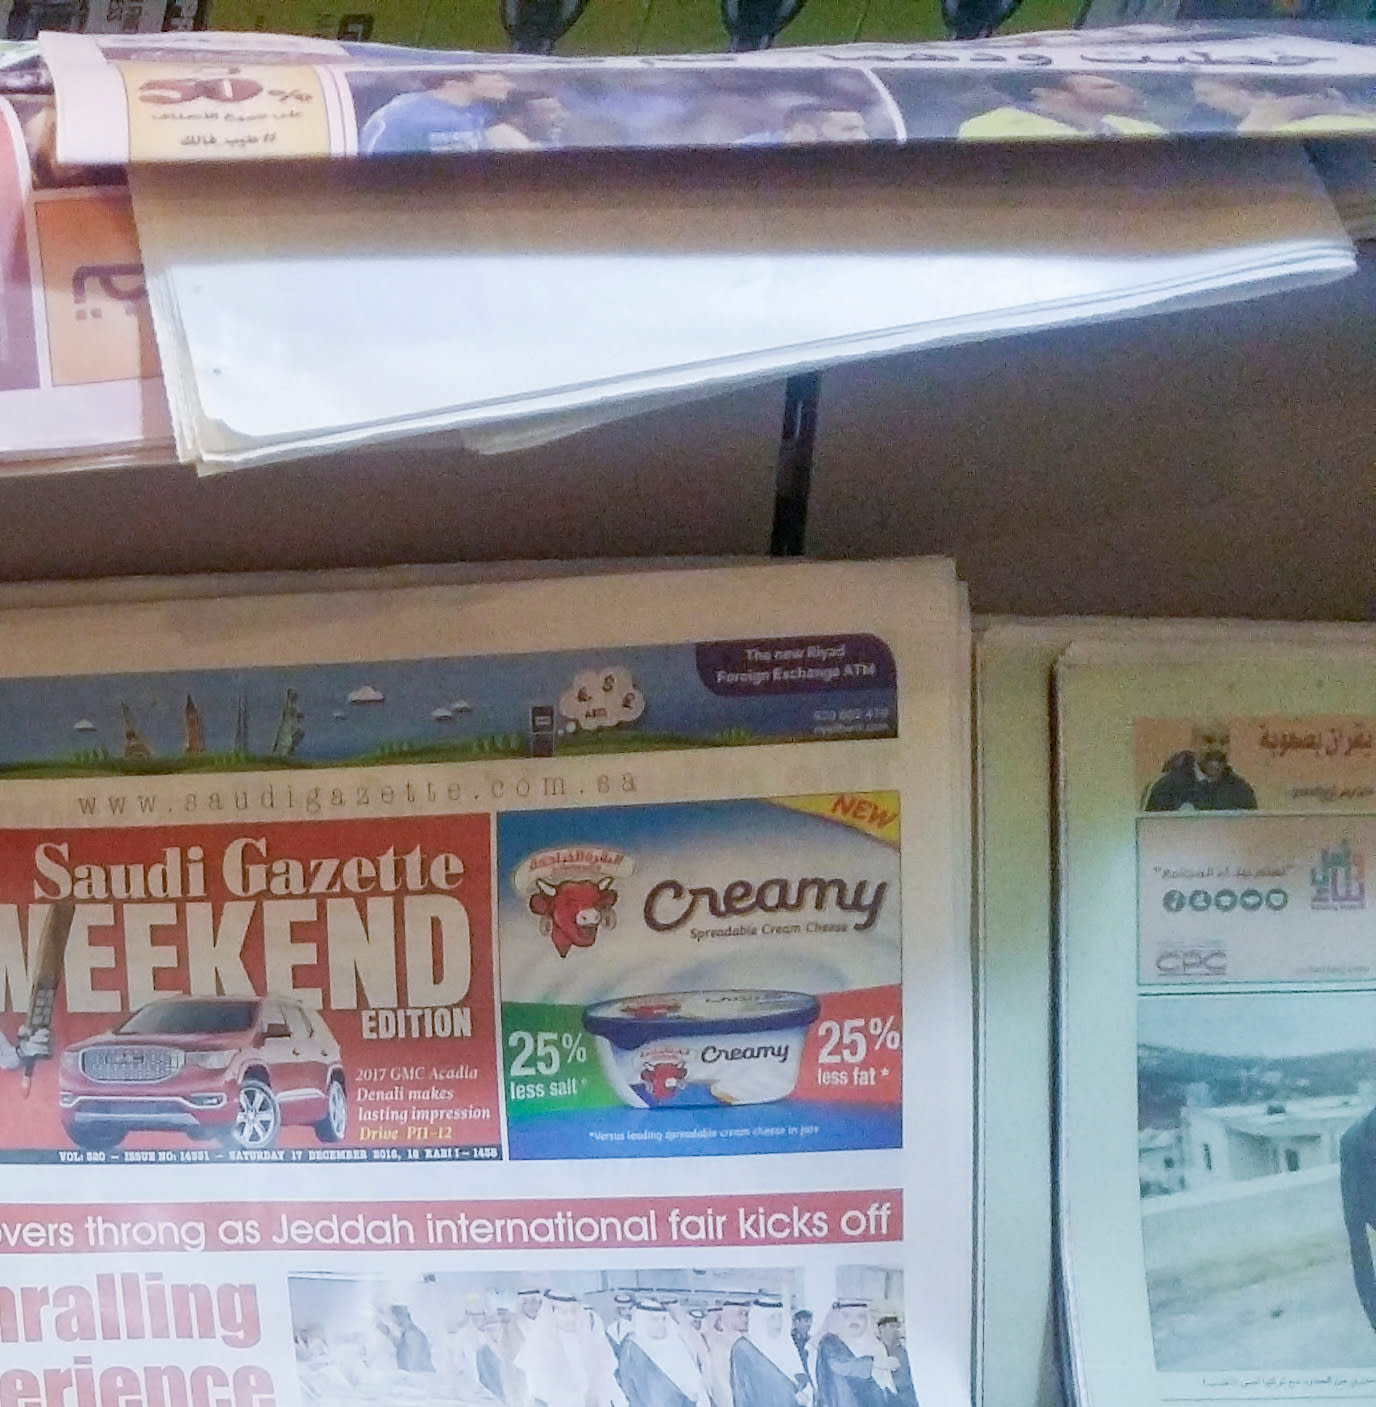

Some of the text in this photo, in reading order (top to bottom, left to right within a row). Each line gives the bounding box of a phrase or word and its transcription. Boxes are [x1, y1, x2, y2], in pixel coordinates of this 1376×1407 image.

[78, 771, 639, 815] www.saudigazette.com.sa
[830, 793, 897, 829] NEW
[33, 836, 466, 902] Saudi Gazette
[644, 876, 889, 932] Creamy
[690, 923, 848, 941] Spreadable Cream Cheese
[361, 1008, 473, 1039] EDITION
[508, 1031, 586, 1077] 25%
[701, 1044, 789, 1063] Creamy
[818, 1016, 900, 1064] 25%
[355, 1065, 478, 1081] 2017 GMC Acadia
[818, 1069, 877, 1086] less fat
[357, 1086, 455, 1101] Denali makes
[510, 1078, 577, 1100] less salt
[358, 1104, 491, 1125] lasting impression
[84, 1216, 206, 1251] throng
[218, 1219, 261, 1244] as
[273, 1213, 414, 1247] Jeddah
[427, 1210, 658, 1246] international
[668, 1207, 726, 1241] fair
[737, 1205, 829, 1240] kicks
[840, 1202, 893, 1236] off
